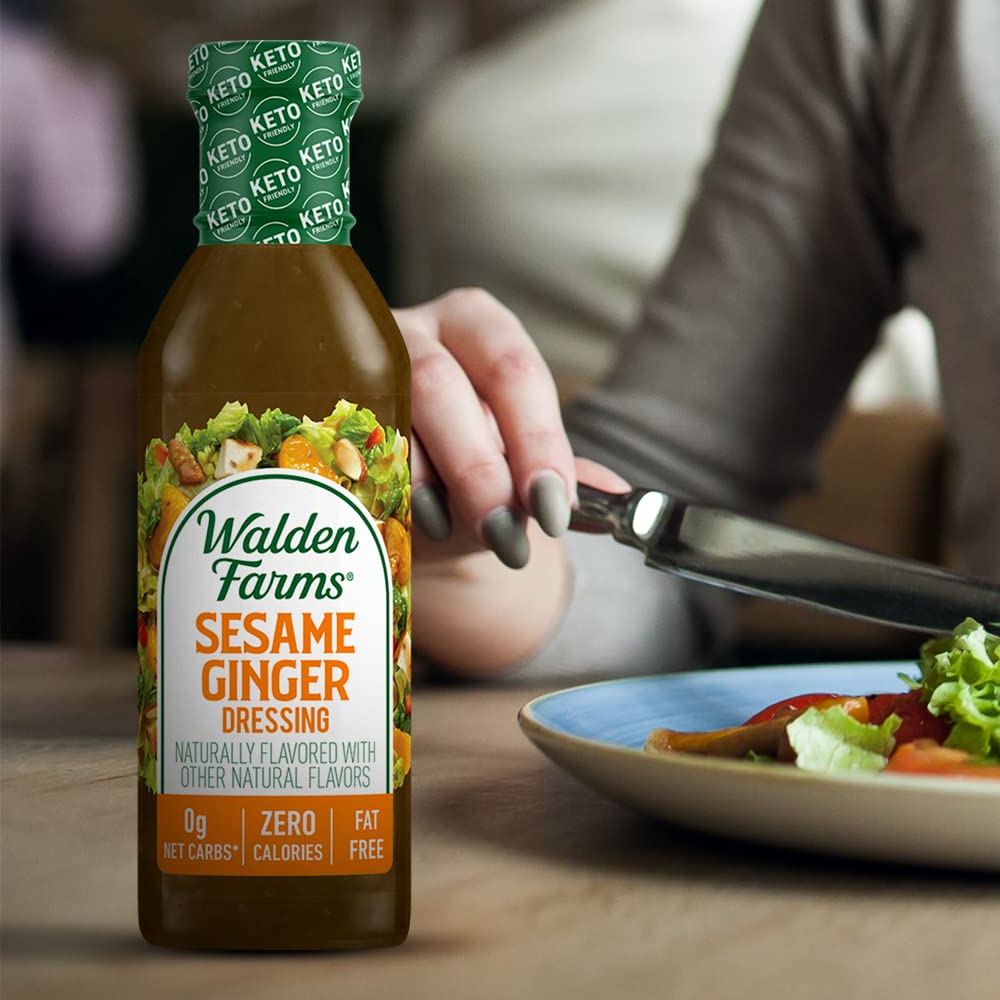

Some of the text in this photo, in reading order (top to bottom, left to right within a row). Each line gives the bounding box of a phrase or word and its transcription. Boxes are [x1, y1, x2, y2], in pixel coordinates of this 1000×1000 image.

[188, 44, 209, 71] ETO
[250, 41, 301, 72] KETO
[341, 50, 361, 74] KET
[263, 61, 295, 78] FRIENDLY
[207, 72, 251, 104] KETO
[217, 92, 246, 109] FRIENDLY
[299, 73, 344, 103] KETO
[311, 94, 339, 109] FRIENDLY
[250, 103, 301, 135] KETO
[263, 123, 295, 140] FRIENDLY
[207, 134, 251, 167] KETO
[217, 154, 246, 172] FRIENDLY
[299, 136, 344, 166] KETO
[311, 156, 339, 171] FRIENDLY
[250, 165, 301, 197] KETO
[263, 186, 295, 202] FRIENDLY
[207, 197, 251, 230] KETO
[217, 217, 246, 235] FRIENDLY
[299, 198, 344, 229] KETO
[311, 219, 339, 235] FRIENDLY
[197, 509, 359, 554] Walden
[195, 612, 356, 655] SESAME
[201, 659, 350, 702] GINGER
[221, 707, 330, 734] DRESSING
[175, 741, 377, 764] NATURALLY FLAVORED WITH
[180, 766, 371, 789] OTHER NATURAL FLAVORS
[184, 807, 207, 840] 0g
[260, 810, 316, 836] ZERO
[355, 809, 380, 831] FAT
[163, 843, 185, 860] NET
[253, 844, 323, 861] CALORIES
[349, 839, 384, 861] FREE
